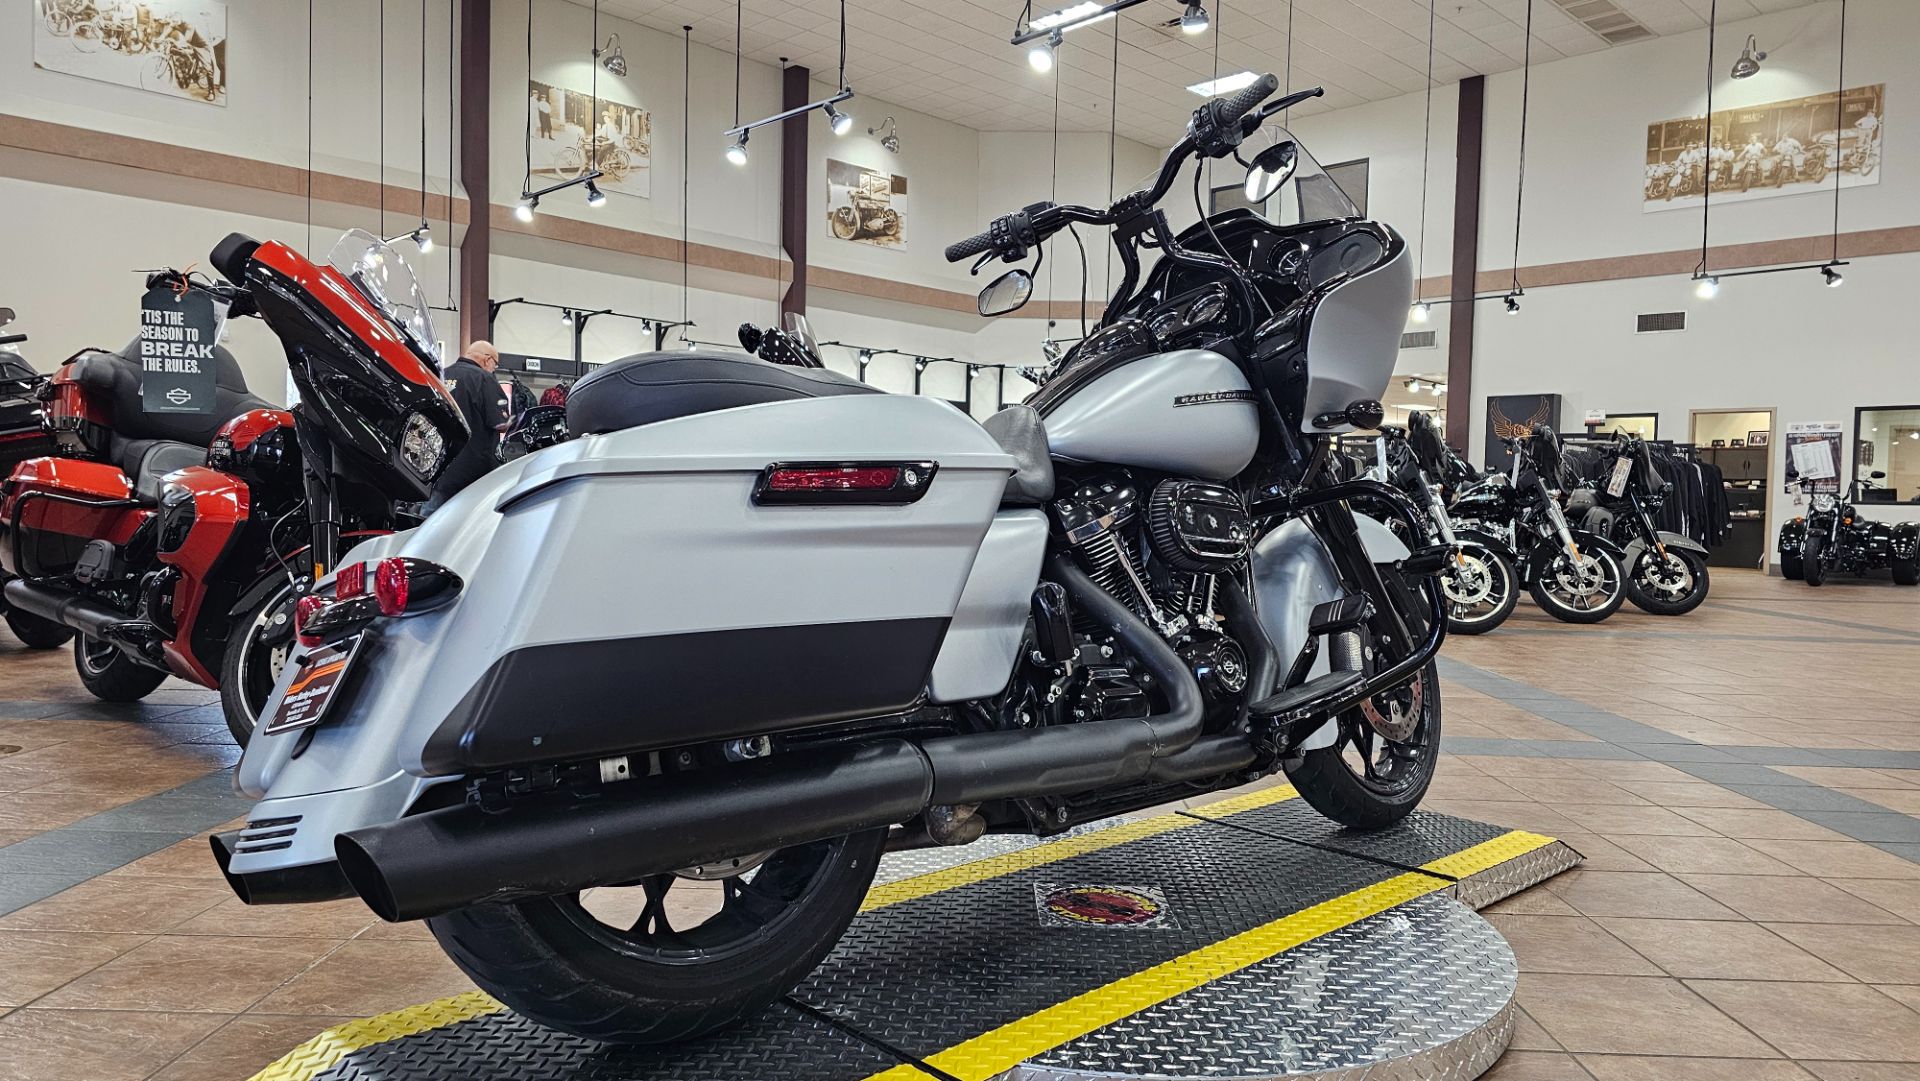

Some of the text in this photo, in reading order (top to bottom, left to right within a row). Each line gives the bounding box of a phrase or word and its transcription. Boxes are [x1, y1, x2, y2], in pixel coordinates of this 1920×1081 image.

[141, 309, 184, 326] 'TIS THE
[141, 325, 199, 342] SEASON TO
[141, 341, 214, 359] BREAK
[142, 357, 201, 373] THE RULES.
